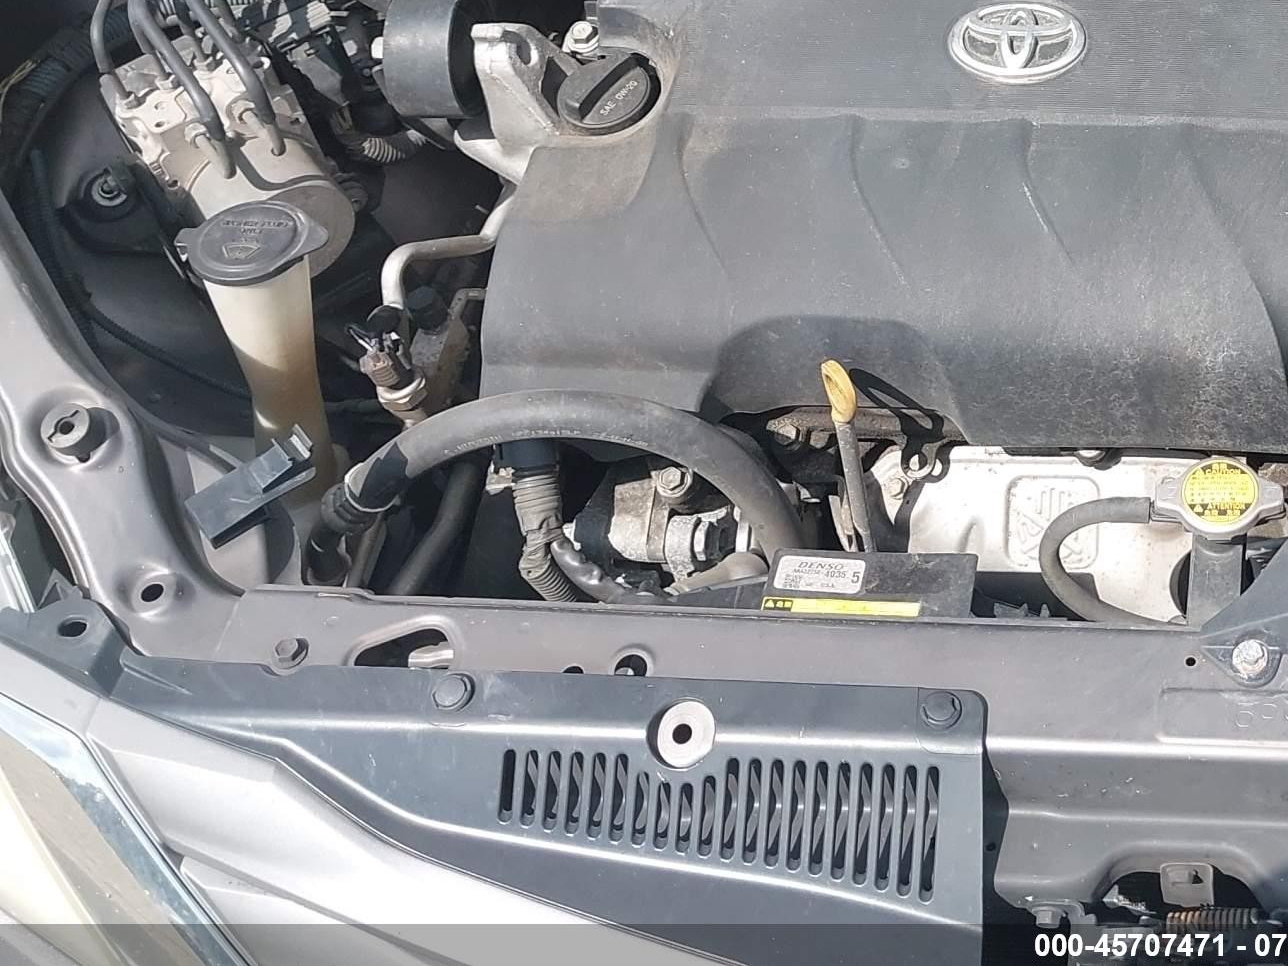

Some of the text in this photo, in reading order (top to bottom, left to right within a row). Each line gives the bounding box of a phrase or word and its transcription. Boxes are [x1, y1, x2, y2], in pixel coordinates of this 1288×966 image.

[600, 80, 638, 116] SAE 0W-20
[798, 561, 845, 571] DENSO
[850, 571, 862, 584] 5
